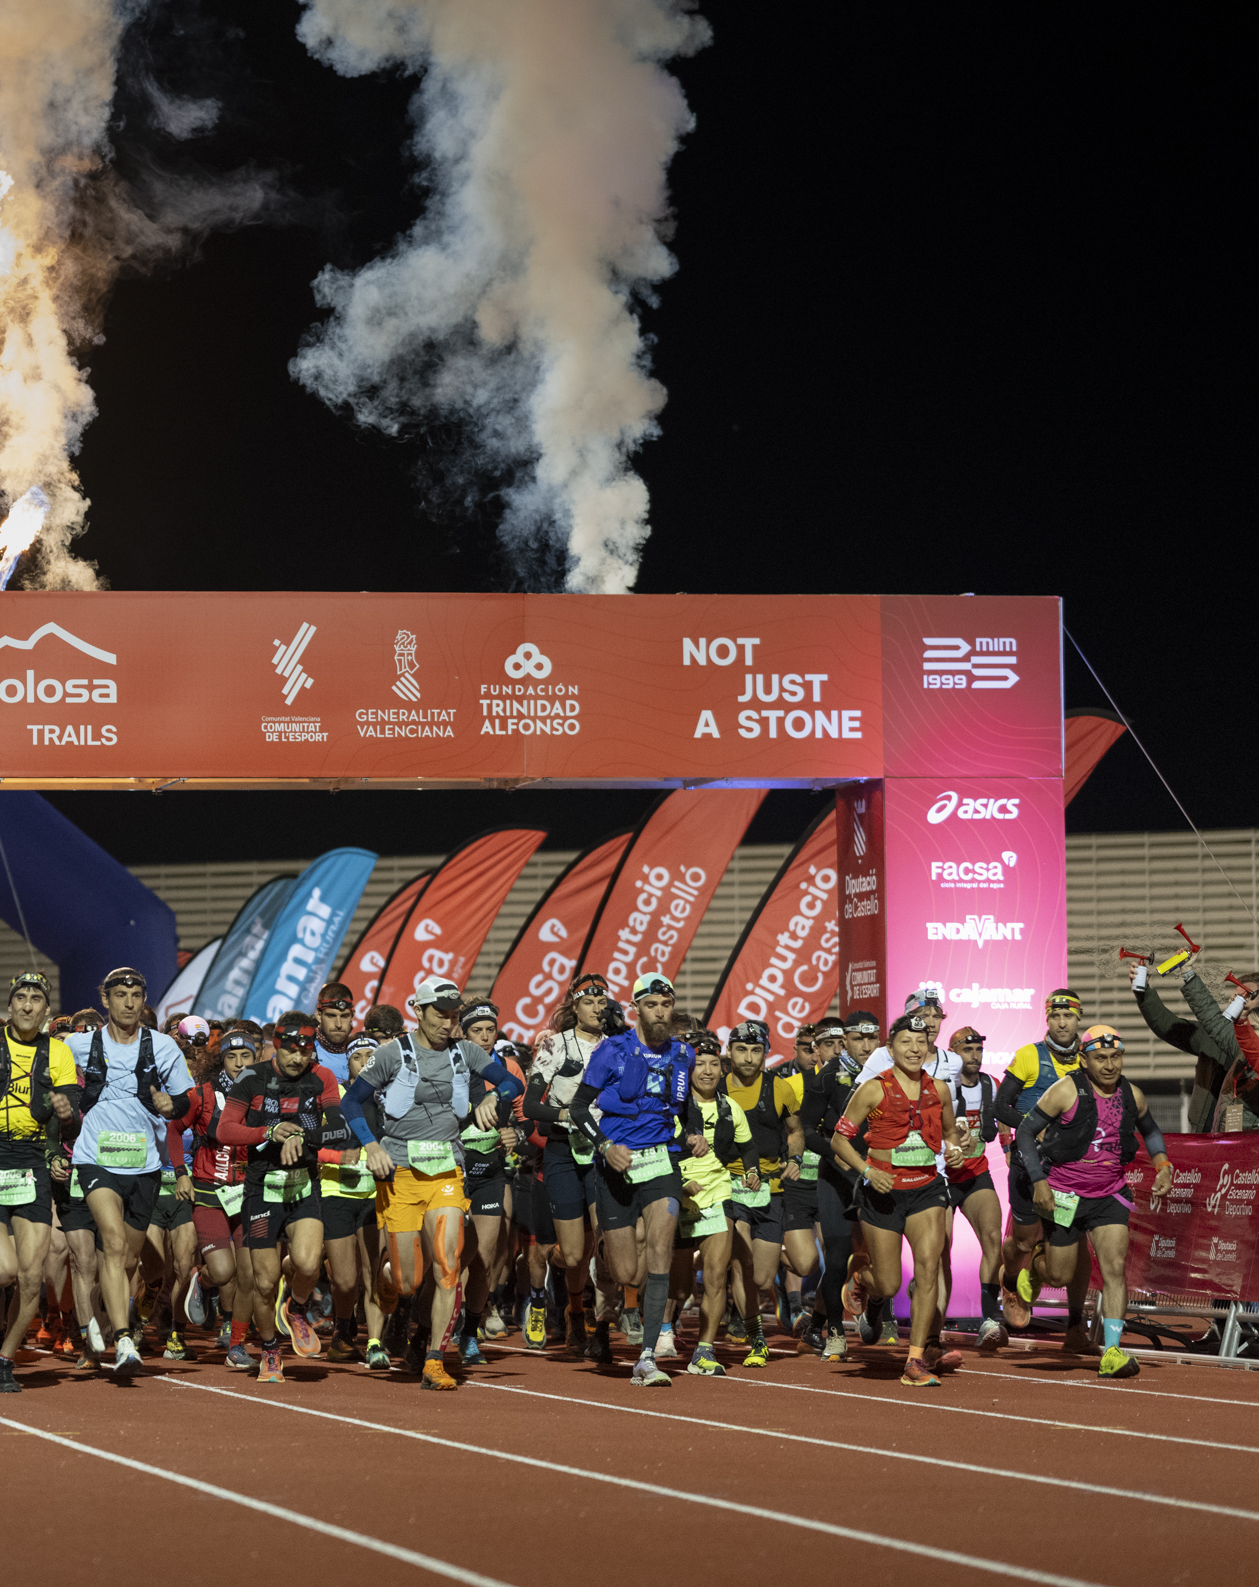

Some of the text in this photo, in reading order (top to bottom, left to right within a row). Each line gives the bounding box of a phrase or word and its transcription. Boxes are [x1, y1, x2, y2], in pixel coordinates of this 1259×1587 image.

[682, 637, 761, 666] NOT
[480, 683, 579, 696] FUNDACIÓN
[737, 673, 829, 703] JUST
[923, 674, 968, 689] 1999
[355, 709, 457, 723] GENERALITAT
[479, 699, 580, 717] TRINIDAD
[261, 722, 321, 733] COMUNITAT
[357, 725, 455, 738] VALENCIANA
[480, 718, 580, 736] ALFONSO
[693, 709, 862, 739] A STONE
[27, 725, 118, 746] TRAILS
[265, 732, 281, 742] DE
[957, 798, 1020, 819] asics
[845, 868, 877, 898] Diputació
[844, 893, 879, 919] de Castelló
[607, 864, 670, 998] iputació
[737, 864, 837, 1021] Diputació
[774, 910, 839, 1039] de Cast
[501, 951, 577, 1044] acsa
[676, 1071, 686, 1102] IPRUN
[109, 1132, 137, 1143] 2006
[1174, 1168, 1202, 1184] Castellón
[1233, 1169, 1259, 1184] Castelló
